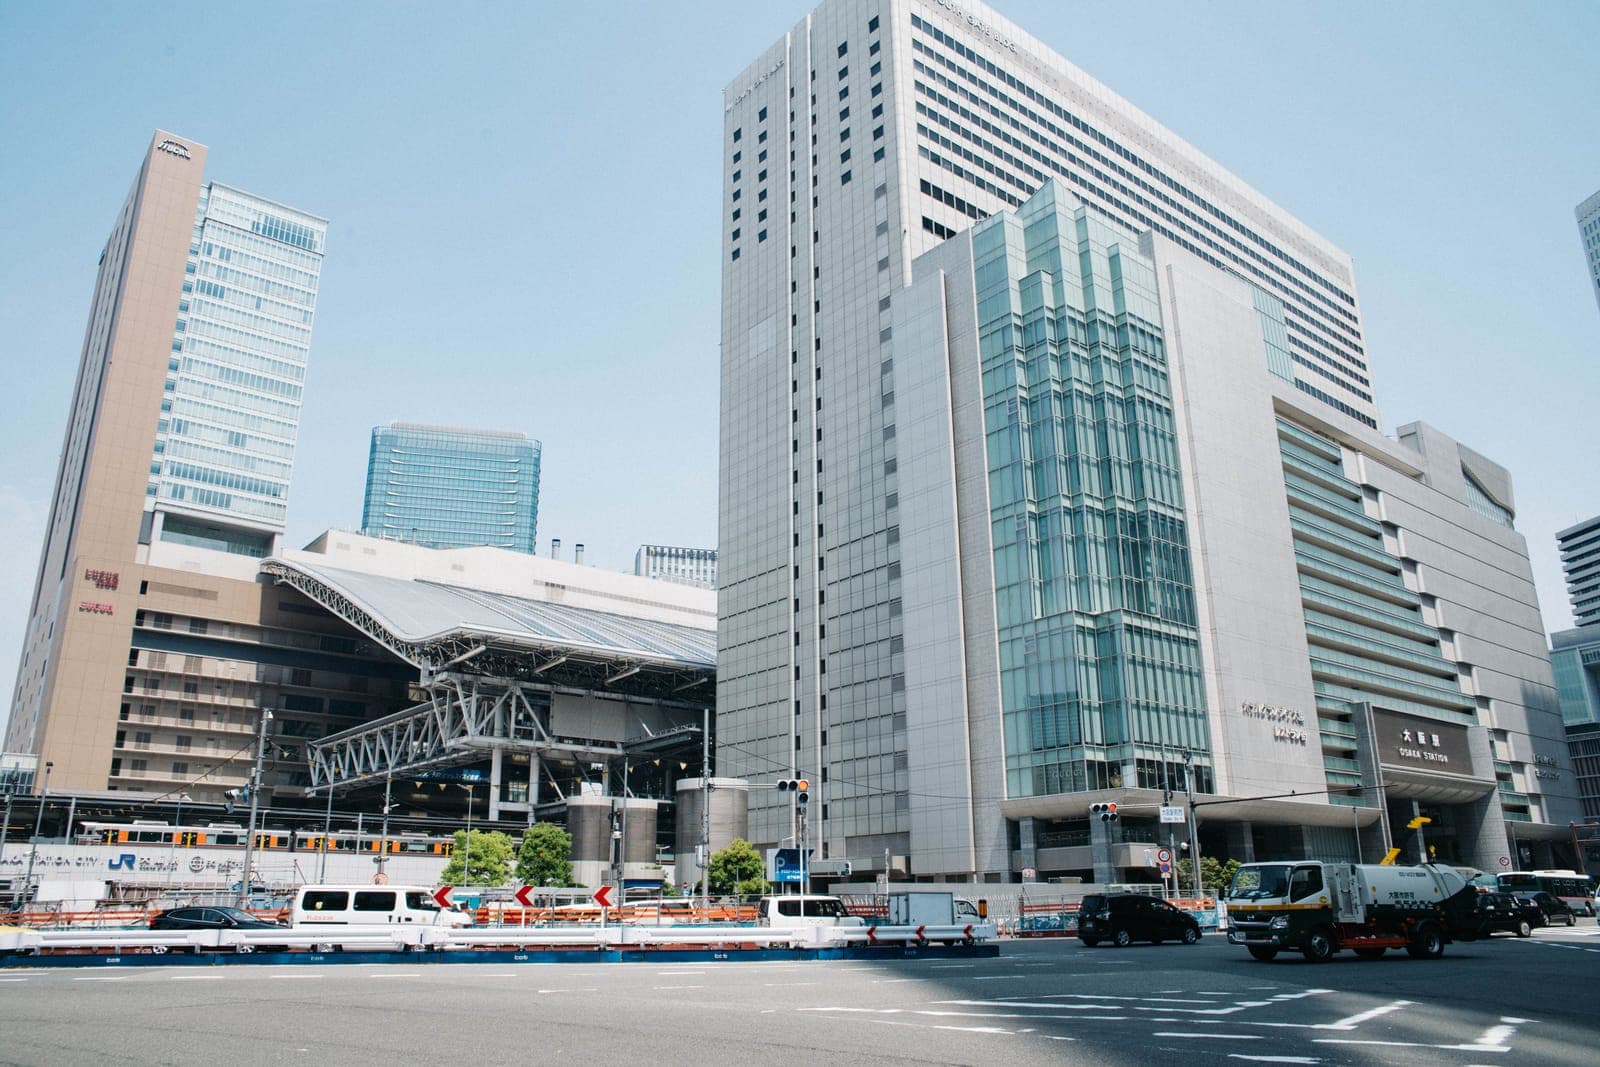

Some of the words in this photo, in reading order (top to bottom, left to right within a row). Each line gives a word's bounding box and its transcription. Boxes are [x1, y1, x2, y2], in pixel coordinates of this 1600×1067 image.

[966, 15, 992, 37] GATE
[1402, 728, 1441, 747] 大阪駅
[1399, 747, 1421, 758] OSAKA
[1422, 751, 1448, 763] STATION
[108, 853, 136, 871] JR
